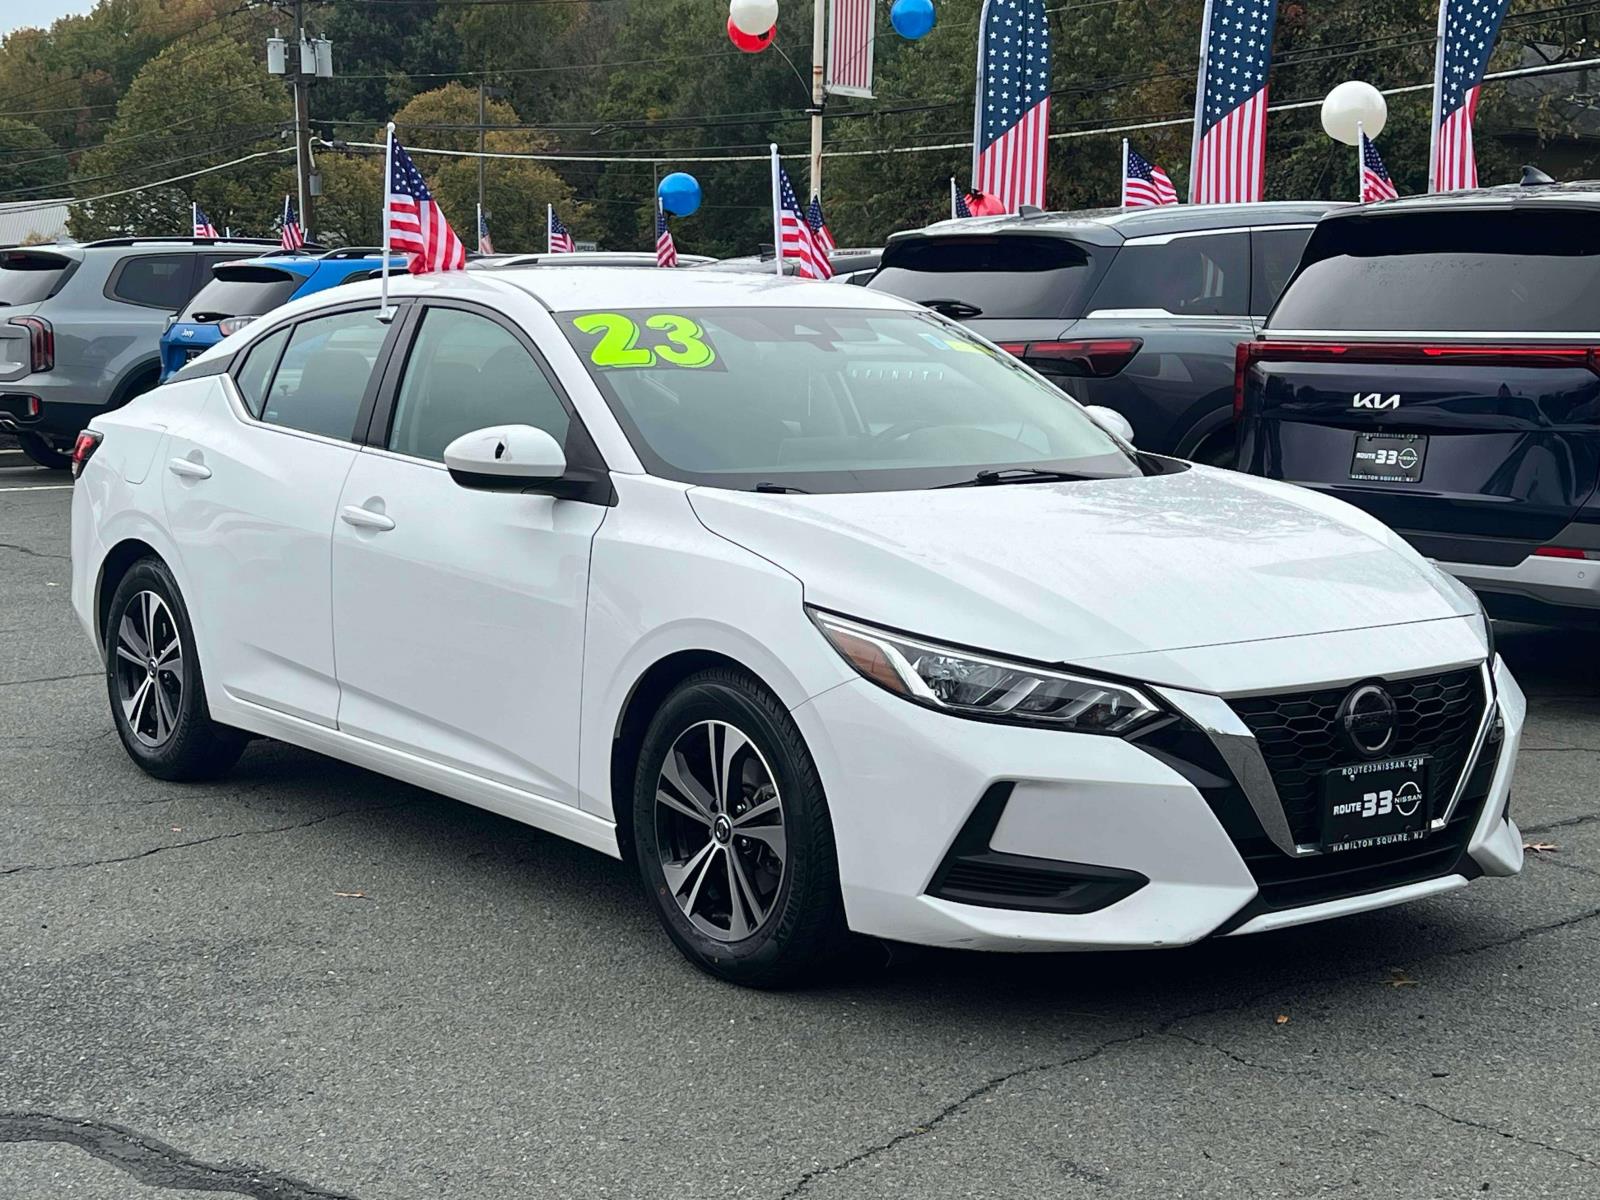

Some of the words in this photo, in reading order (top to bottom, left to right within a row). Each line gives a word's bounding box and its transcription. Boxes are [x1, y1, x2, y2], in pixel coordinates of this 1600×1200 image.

[572, 312, 716, 369] 23
[1353, 392, 1401, 410] KIA
[1375, 449, 1398, 465] 33
[1333, 801, 1362, 816] ROUTE
[1362, 789, 1393, 818] 33
[1394, 793, 1422, 804] NISSAN
[1333, 839, 1373, 852] HAMILTON
[1413, 831, 1424, 839] NJ
